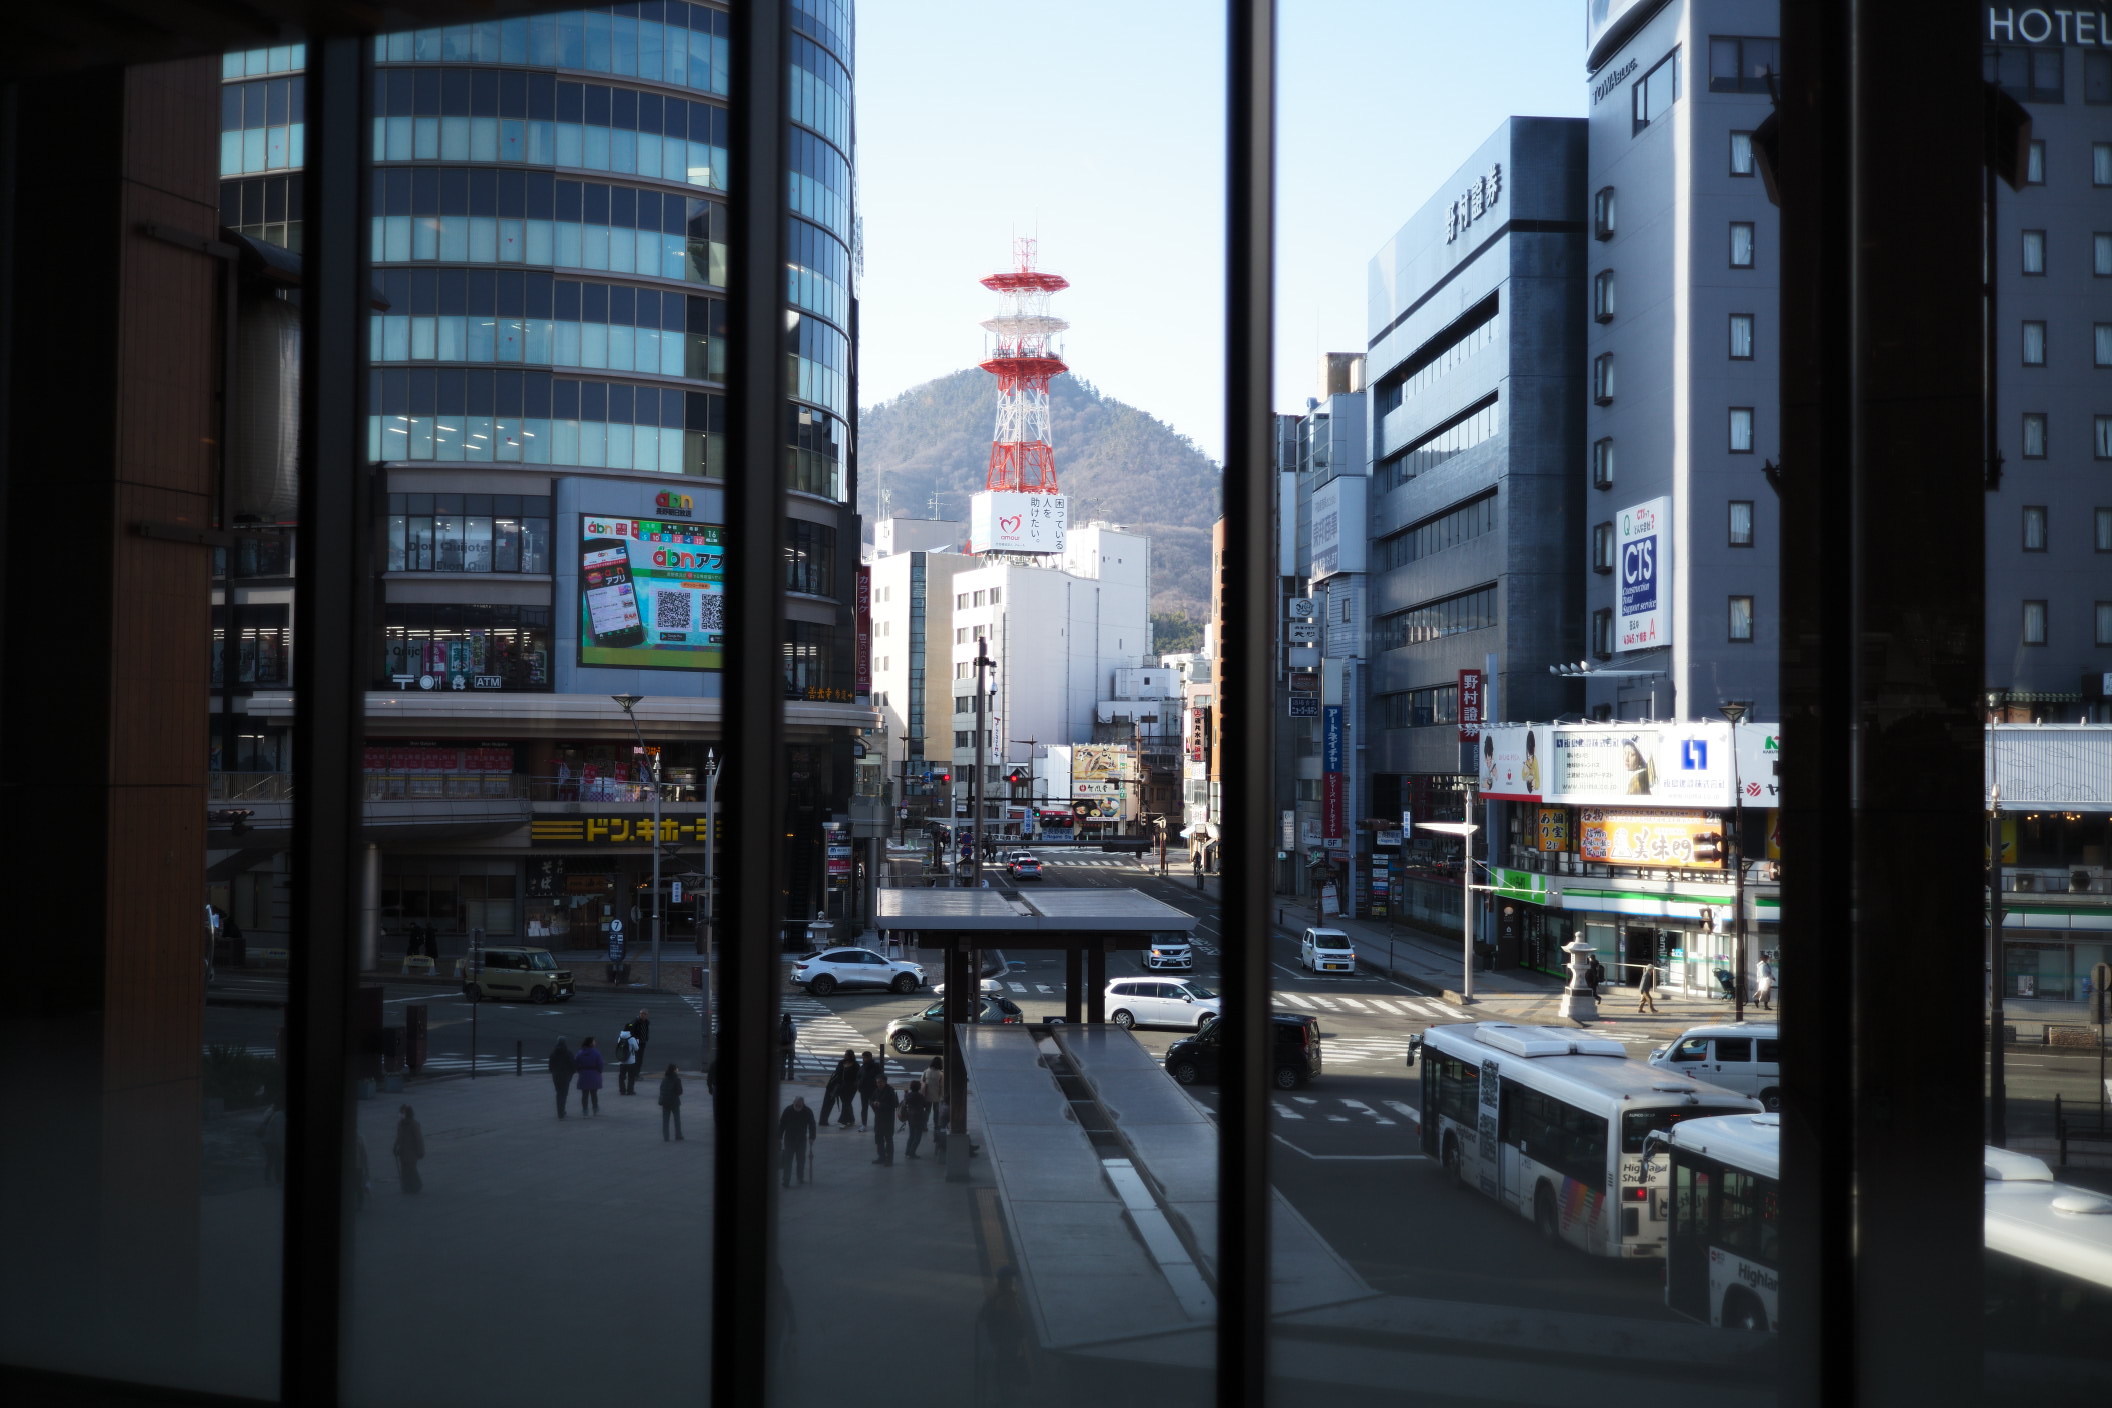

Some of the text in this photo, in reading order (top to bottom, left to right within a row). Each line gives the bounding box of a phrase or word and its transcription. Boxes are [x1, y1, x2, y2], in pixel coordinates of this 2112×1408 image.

[1990, 7, 2112, 45] HOTEL
[1043, 498, 1052, 519] 人を
[1055, 498, 1065, 550] 困っている
[1625, 540, 1652, 584] CTS
[860, 575, 868, 613] カラオケ
[476, 676, 500, 686] ATM
[1328, 708, 1338, 770] アートネイチャー
[1540, 813, 1550, 838] あり
[1552, 812, 1563, 838] 個室
[1581, 808, 1604, 822] 名物
[1327, 839, 1337, 847] 5F
[1546, 840, 1559, 850] 2F
[614, 921, 620, 930] 7
